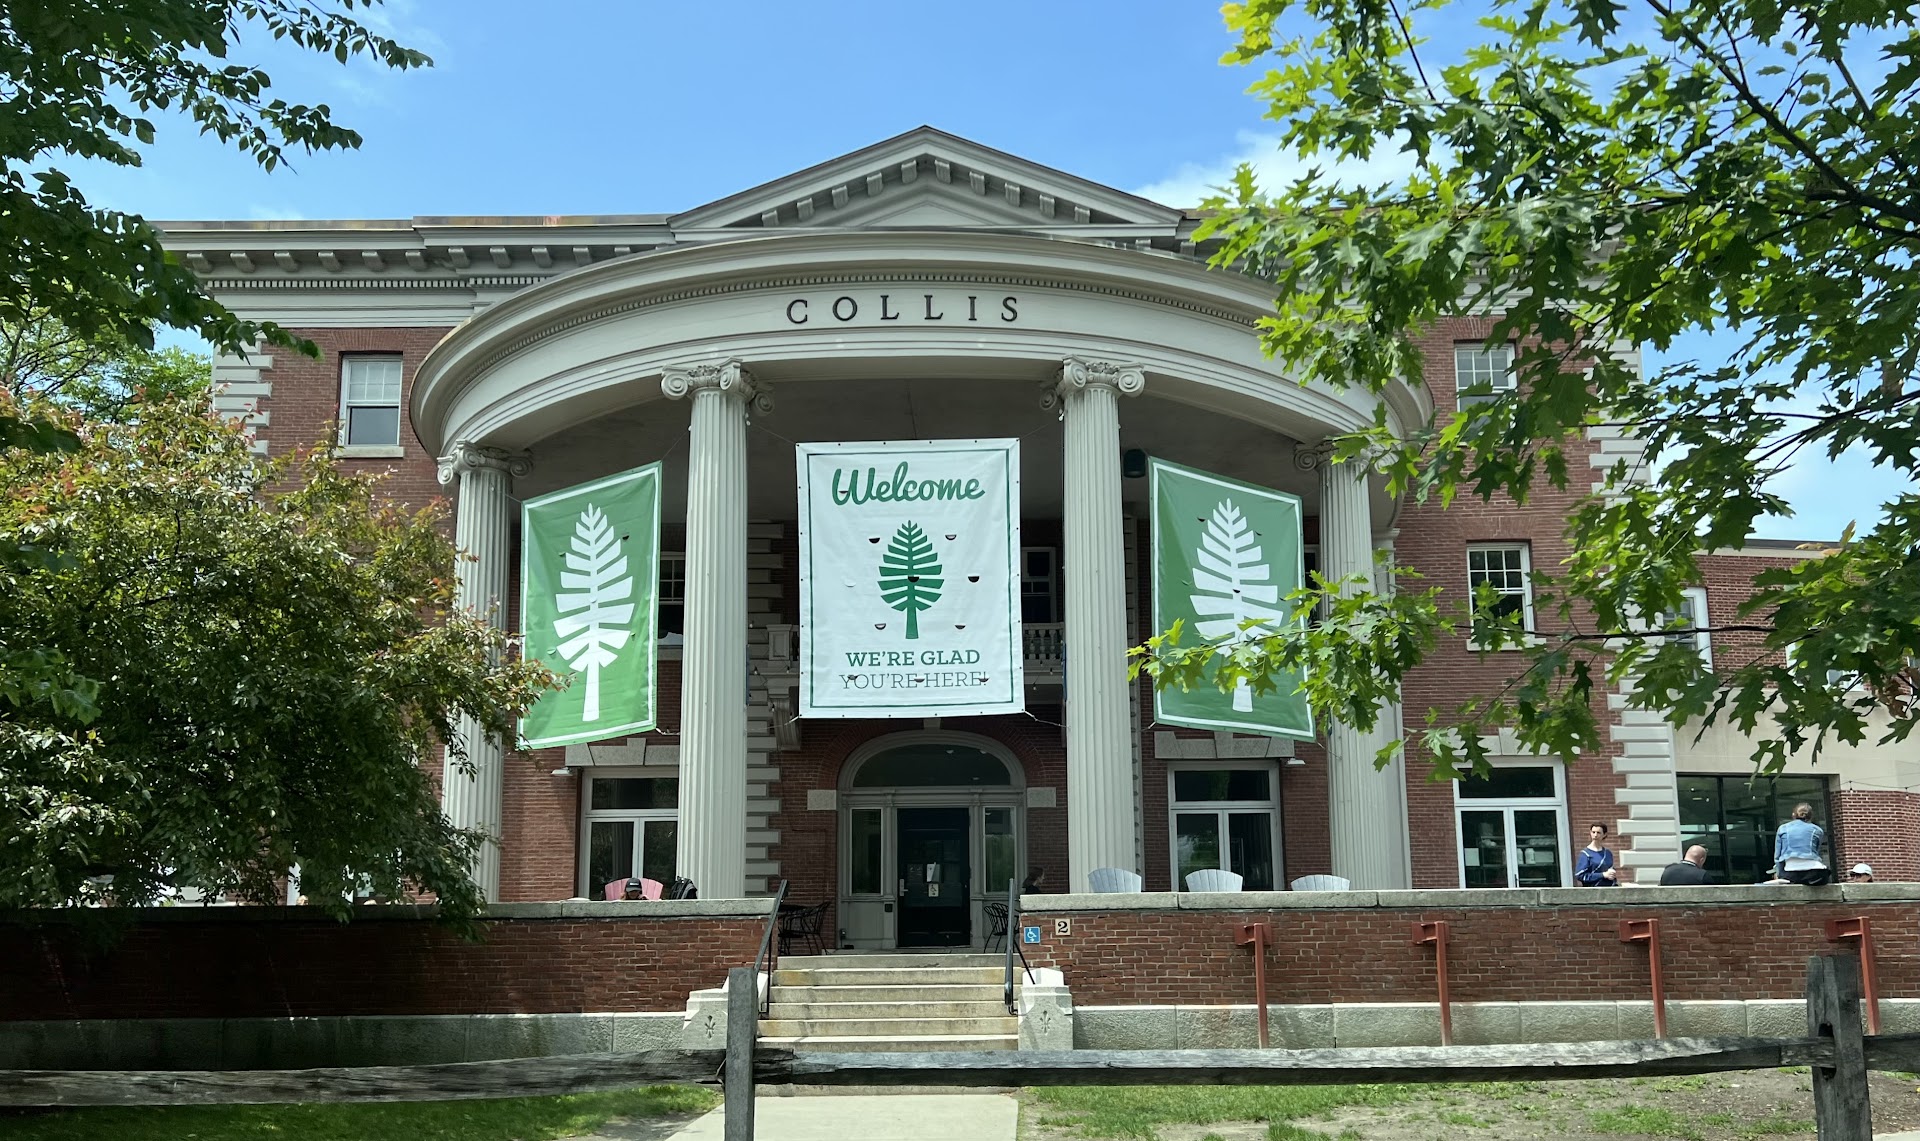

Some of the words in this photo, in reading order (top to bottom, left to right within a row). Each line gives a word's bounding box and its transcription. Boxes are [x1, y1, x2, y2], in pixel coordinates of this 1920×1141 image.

[786, 295, 1018, 324] COLLIS
[832, 461, 986, 505] Welcome
[920, 649, 980, 665] GLAD
[924, 671, 987, 688] HERE!
[1058, 921, 1068, 933] 2
